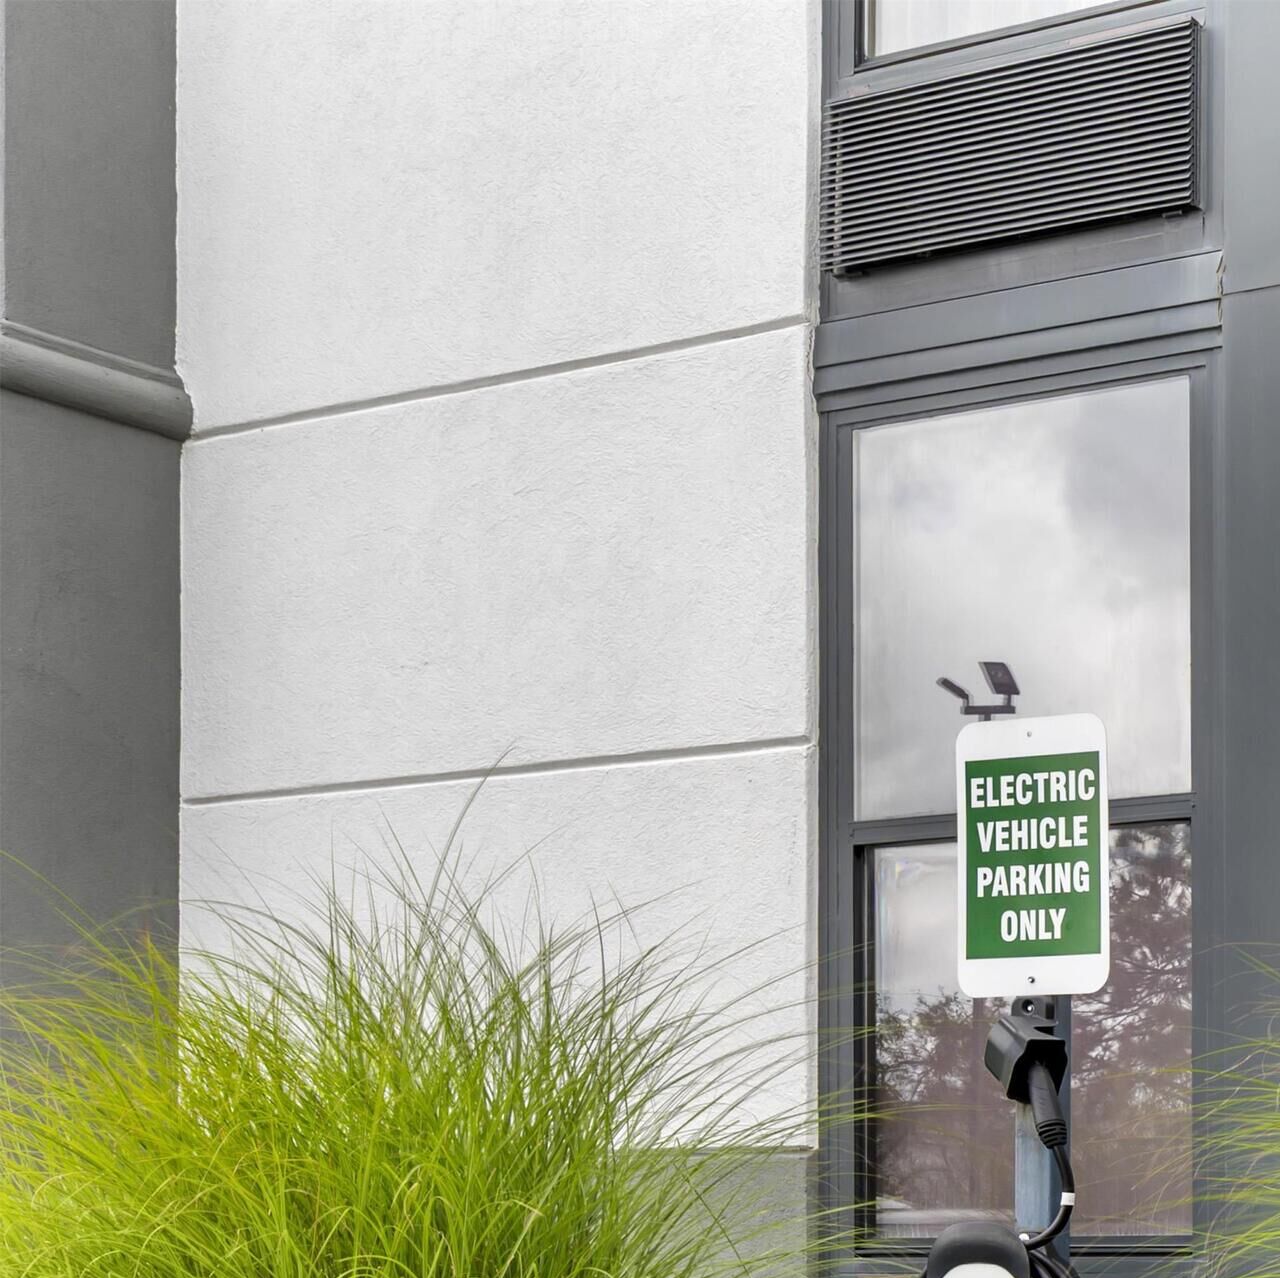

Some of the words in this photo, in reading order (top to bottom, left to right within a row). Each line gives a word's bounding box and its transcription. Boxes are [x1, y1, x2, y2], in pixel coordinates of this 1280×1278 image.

[970, 768, 1096, 808] ELECTRIC
[976, 815, 1088, 853] VEHICLE
[976, 860, 1091, 898] PARKING
[1000, 907, 1067, 942] ONLY
